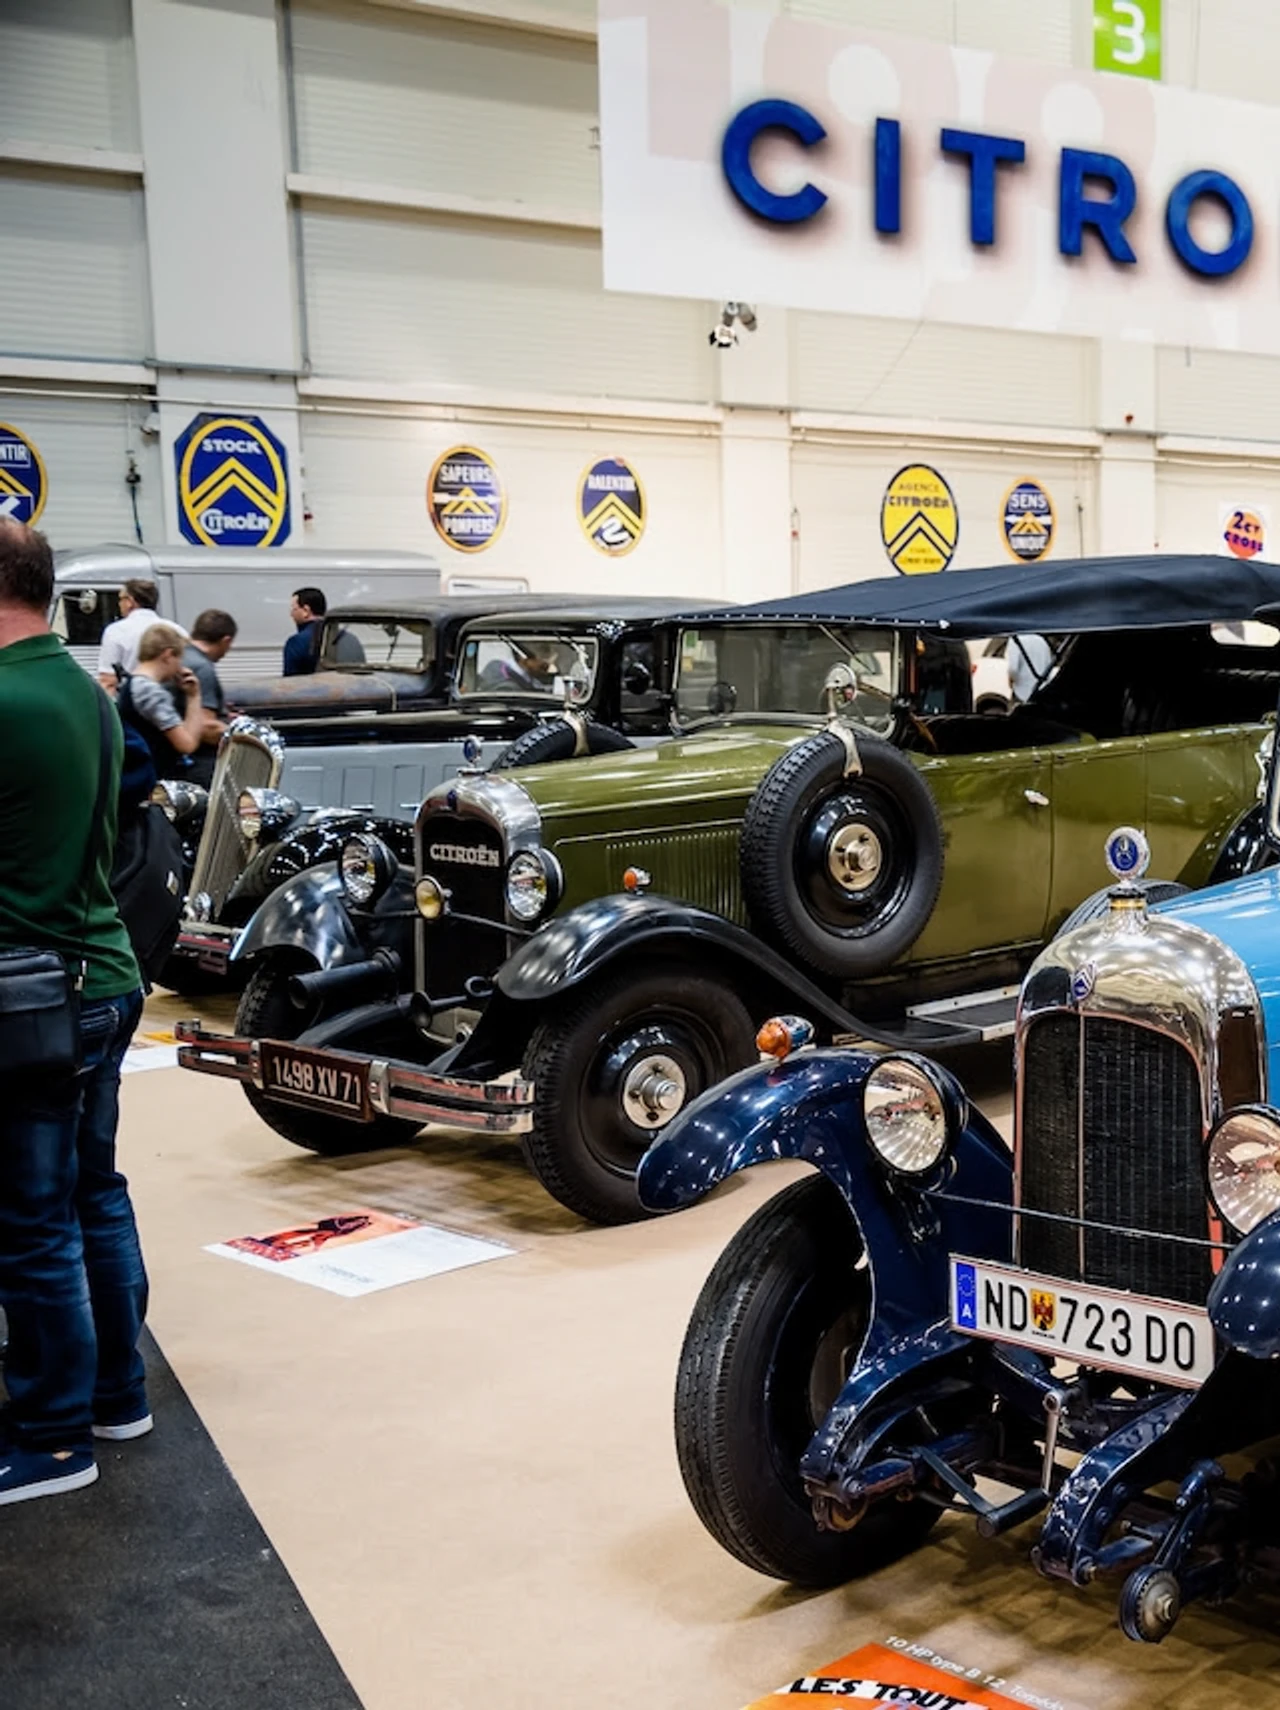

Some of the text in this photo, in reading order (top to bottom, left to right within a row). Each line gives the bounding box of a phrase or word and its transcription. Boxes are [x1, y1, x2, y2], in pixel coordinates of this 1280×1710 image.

[1112, 1, 1146, 65] 3
[202, 437, 263, 456] STOCK
[439, 464, 493, 484] SAPEURS
[898, 482, 940, 493] AGENCE
[1009, 493, 1047, 510] SENS
[442, 515, 497, 536] POMPIERS
[429, 843, 500, 868] CITROËN
[273, 1056, 362, 1104] 1498 XV 71
[961, 1303, 973, 1320] A
[984, 1279, 1029, 1332] ND
[1059, 1296, 1132, 1358] 723
[885, 1635, 909, 1649] 10
[905, 1643, 934, 1659] HP
[964, 1665, 984, 1679] B
[982, 1674, 1008, 1690] 12
[789, 1677, 863, 1695] LES
